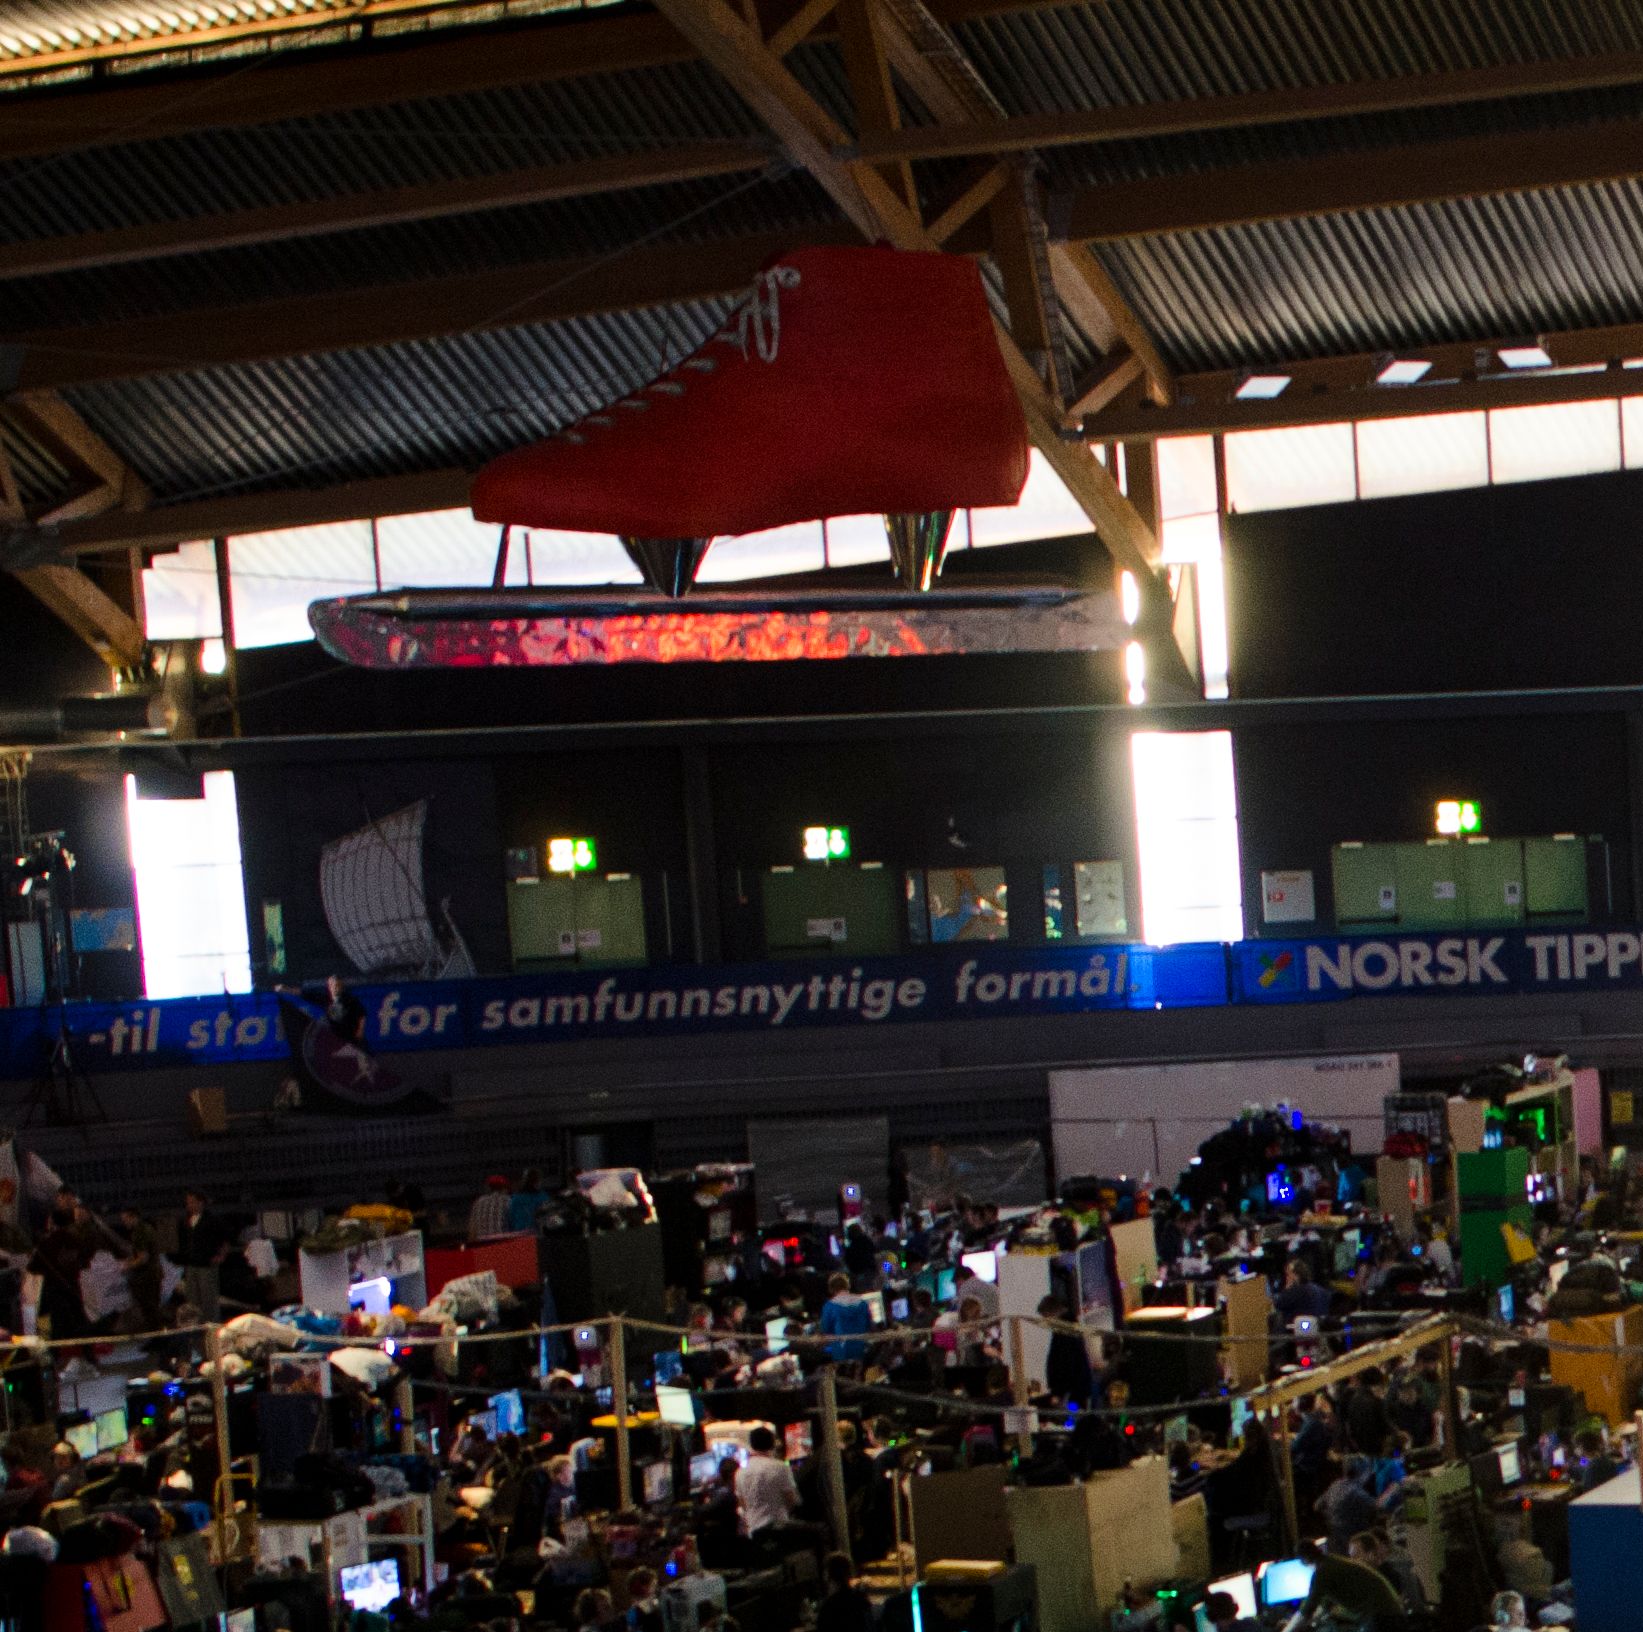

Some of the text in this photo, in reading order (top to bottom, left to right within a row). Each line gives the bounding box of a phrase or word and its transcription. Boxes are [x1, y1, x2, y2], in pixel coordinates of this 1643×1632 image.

[88, 1007, 161, 1056] -til
[375, 991, 458, 1037] for
[480, 967, 927, 1031] samfunnsnyttige
[955, 952, 1139, 1003] formål.
[1305, 936, 1509, 992] NORSK
